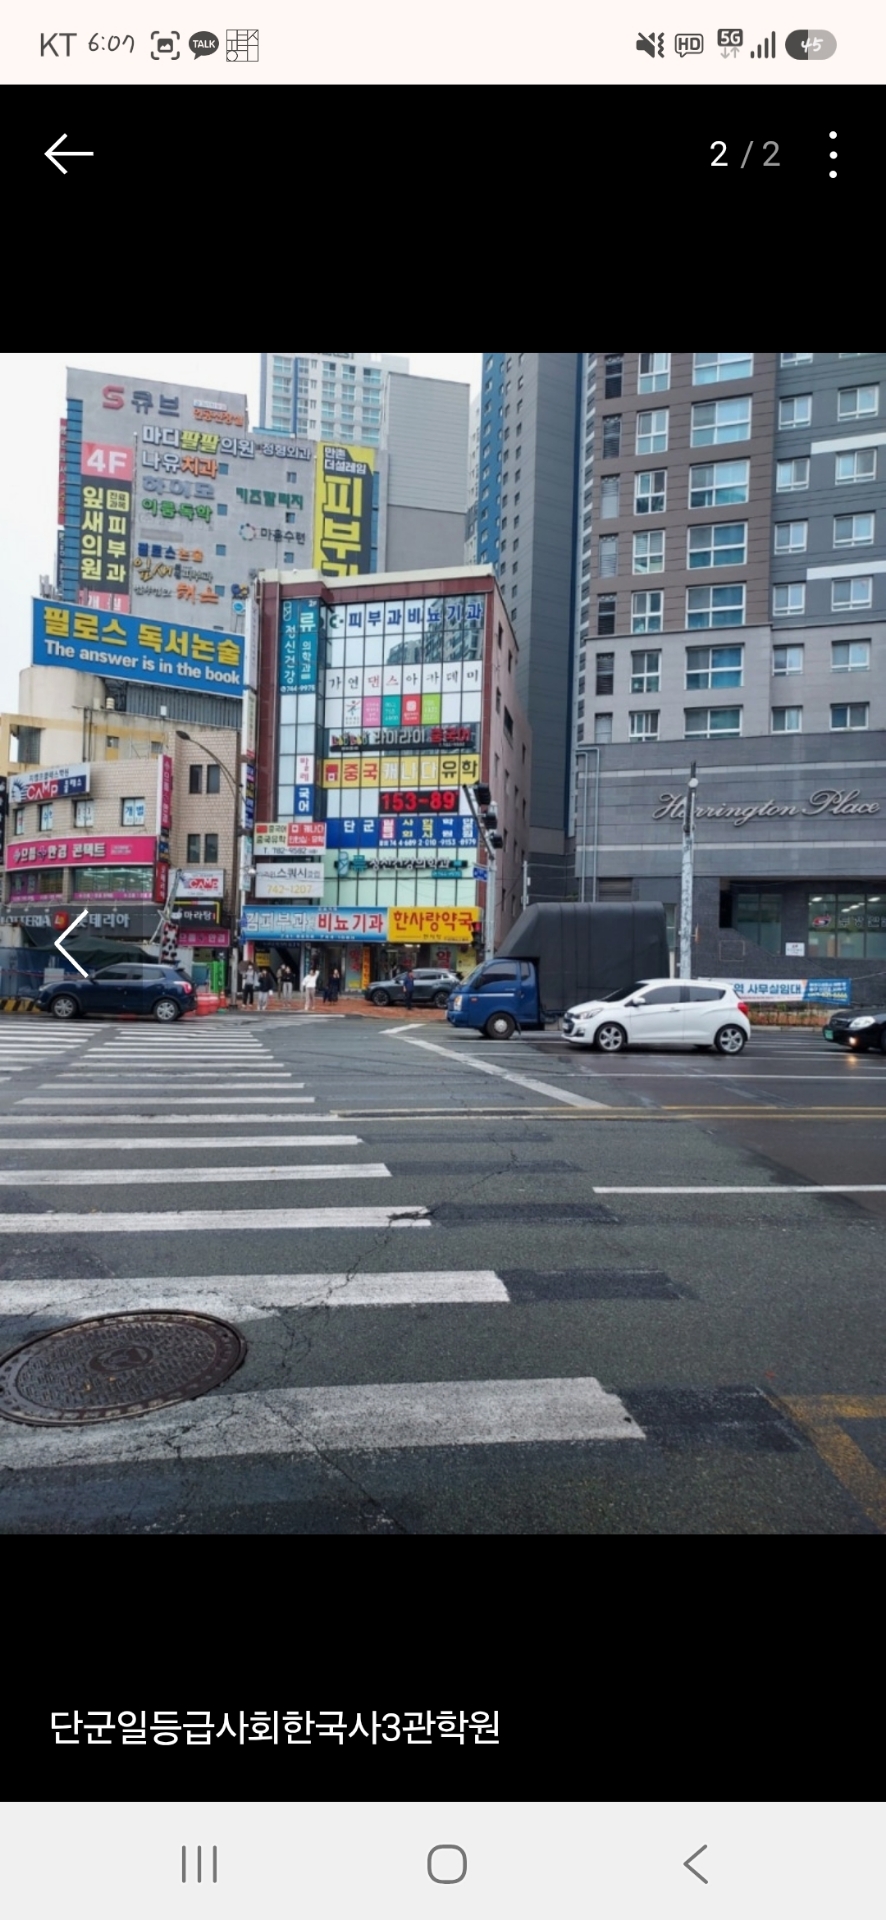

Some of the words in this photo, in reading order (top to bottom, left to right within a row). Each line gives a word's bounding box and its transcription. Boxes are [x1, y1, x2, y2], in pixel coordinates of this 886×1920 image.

[102, 384, 180, 417] S큐브
[142, 425, 255, 459] 마디팔팔의원
[262, 443, 312, 461] 정형외과
[86, 449, 127, 474] 4F
[142, 450, 218, 479] 나유치과
[324, 458, 367, 475] 더설레임
[80, 486, 104, 581] 잎새의원
[260, 527, 306, 545] 마음수련
[106, 516, 127, 583] 피부과
[300, 612, 316, 633] 류
[349, 602, 483, 629] 피부과비뇨기과
[44, 606, 128, 646] 필로스
[138, 623, 241, 667] 독서논술
[44, 639, 75, 658] The
[79, 647, 138, 668] answer
[142, 655, 155, 671] is
[159, 658, 173, 674] in
[176, 662, 201, 679] the
[205, 666, 241, 685] book
[284, 625, 296, 685] 정신건강
[301, 641, 312, 673] 의학과
[344, 763, 378, 782] 중국
[382, 761, 437, 780] 캐나다
[442, 760, 478, 778] 유학
[26, 781, 59, 800] CAMP
[298, 787, 310, 813] 국어
[802, 789, 881, 816] Place
[344, 820, 374, 833] 단군
[183, 910, 212, 921] 마라탕
[246, 912, 308, 932] 김피부과
[318, 913, 384, 933] 비뇨기과
[393, 911, 473, 932] 한사랑약국
[748, 983, 802, 995] 사무실임대
